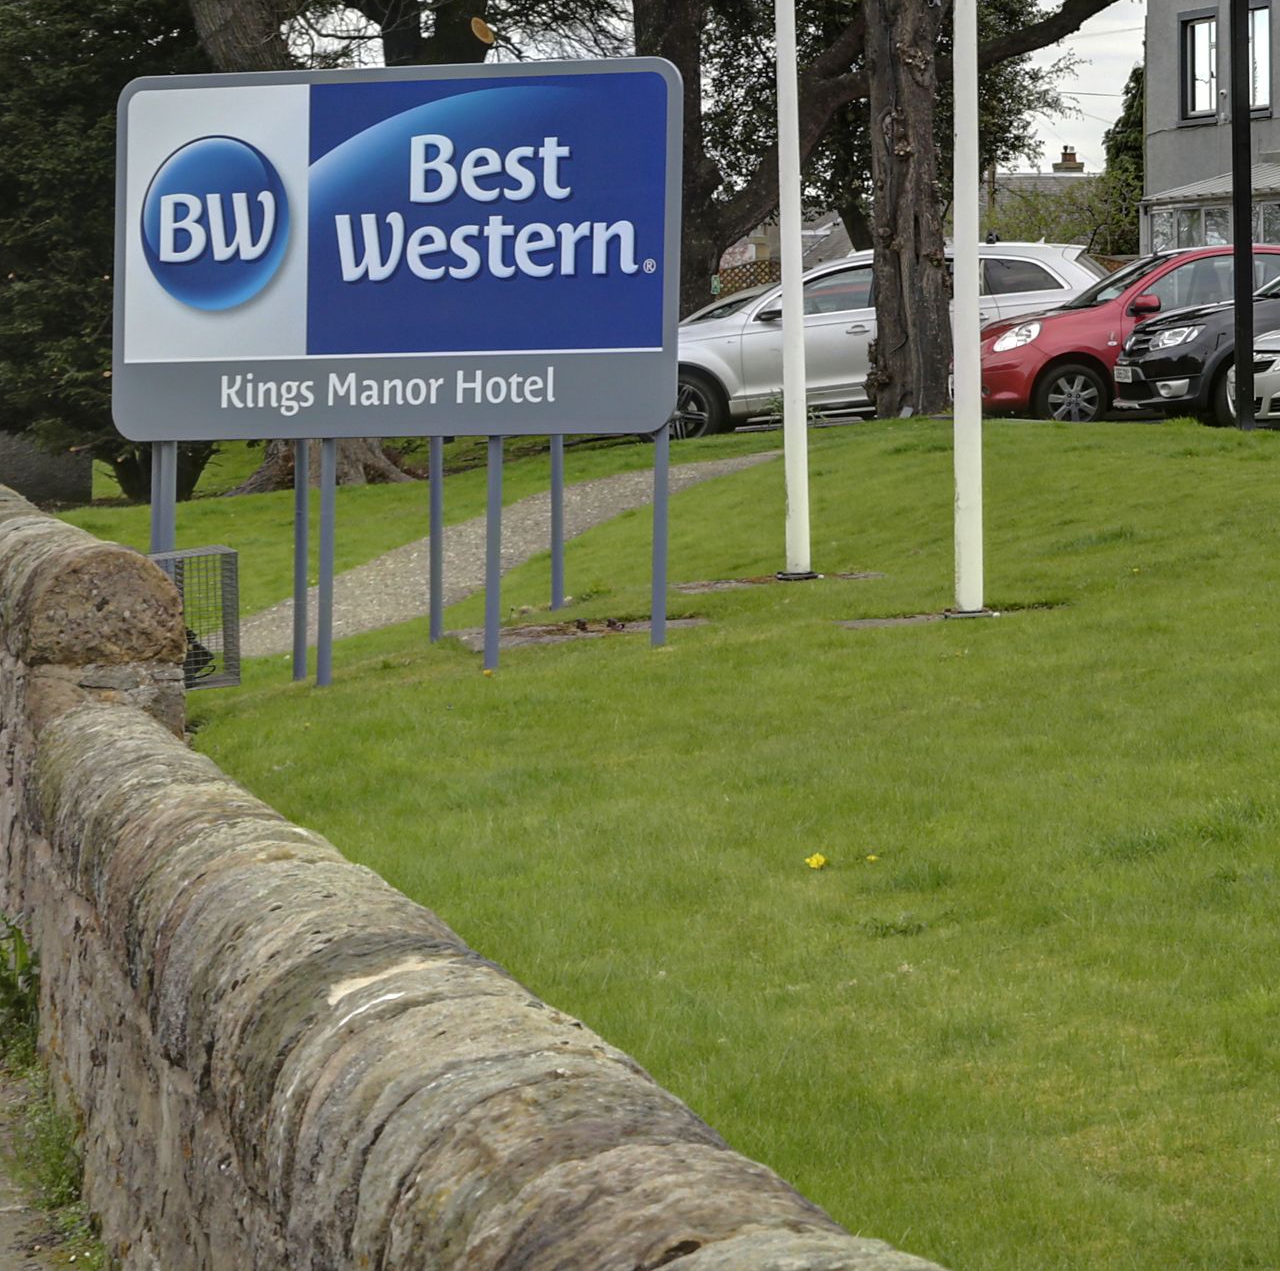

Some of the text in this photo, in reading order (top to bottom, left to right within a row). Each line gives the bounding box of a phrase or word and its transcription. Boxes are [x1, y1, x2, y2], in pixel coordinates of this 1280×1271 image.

[408, 133, 572, 204] Best
[158, 190, 277, 264] BW
[220, 366, 556, 416] Kings Manor Hotel
